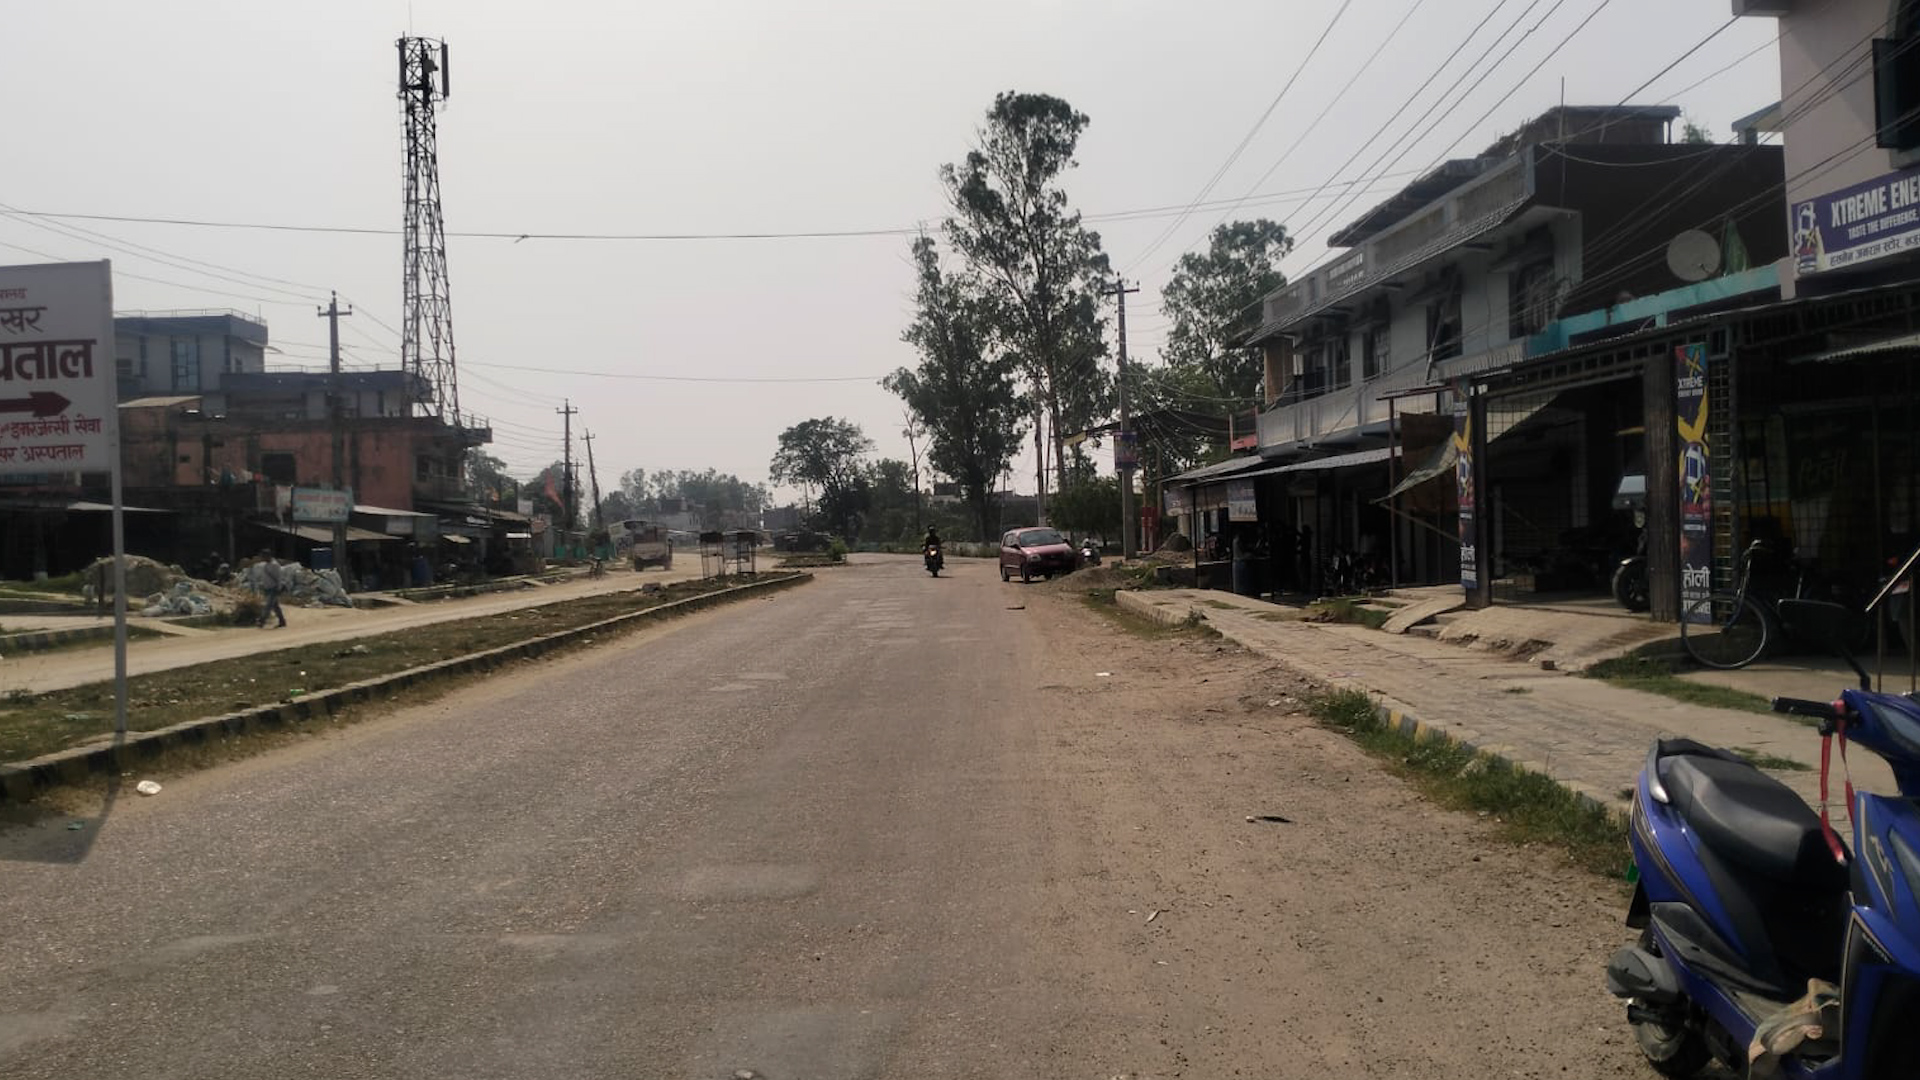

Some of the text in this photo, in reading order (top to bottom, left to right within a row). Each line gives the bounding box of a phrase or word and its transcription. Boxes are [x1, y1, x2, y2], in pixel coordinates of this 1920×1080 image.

[1831, 174, 1920, 228] XTREME ENE
[74, 413, 102, 434] सेवा
[21, 444, 86, 462] अस्पताल
[1682, 563, 1711, 589] होली
